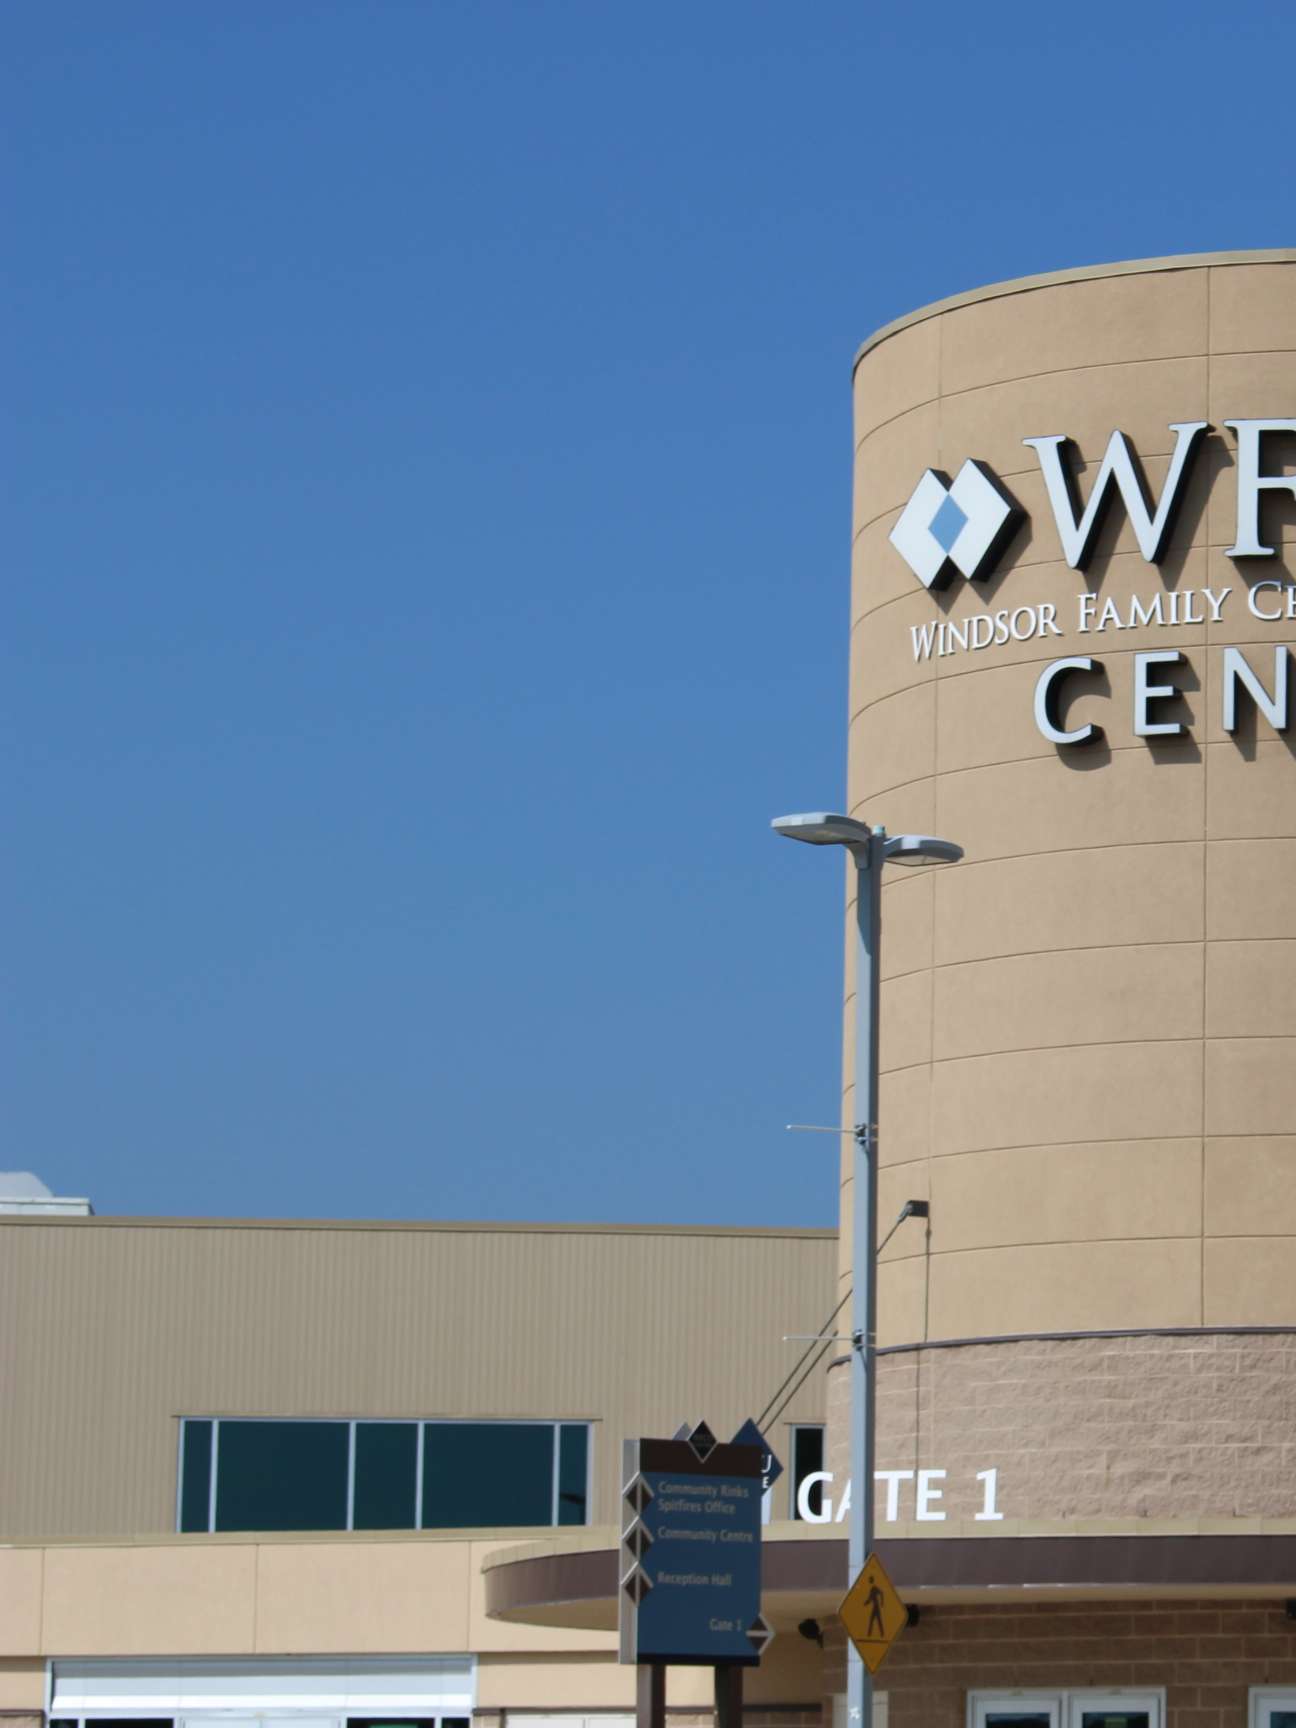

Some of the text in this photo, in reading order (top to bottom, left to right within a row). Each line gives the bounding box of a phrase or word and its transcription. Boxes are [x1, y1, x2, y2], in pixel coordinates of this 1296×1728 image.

[910, 603, 1060, 663] WINDSOR
[1075, 586, 1232, 633] FAMILY
[657, 1481, 749, 1498] Community Rinks
[974, 1467, 1004, 1521] 1
[657, 1499, 737, 1515] Spitfires Office
[657, 1526, 753, 1543] Community Centre
[657, 1572, 732, 1587] Reception Hall
[709, 1618, 733, 1631] Gate
